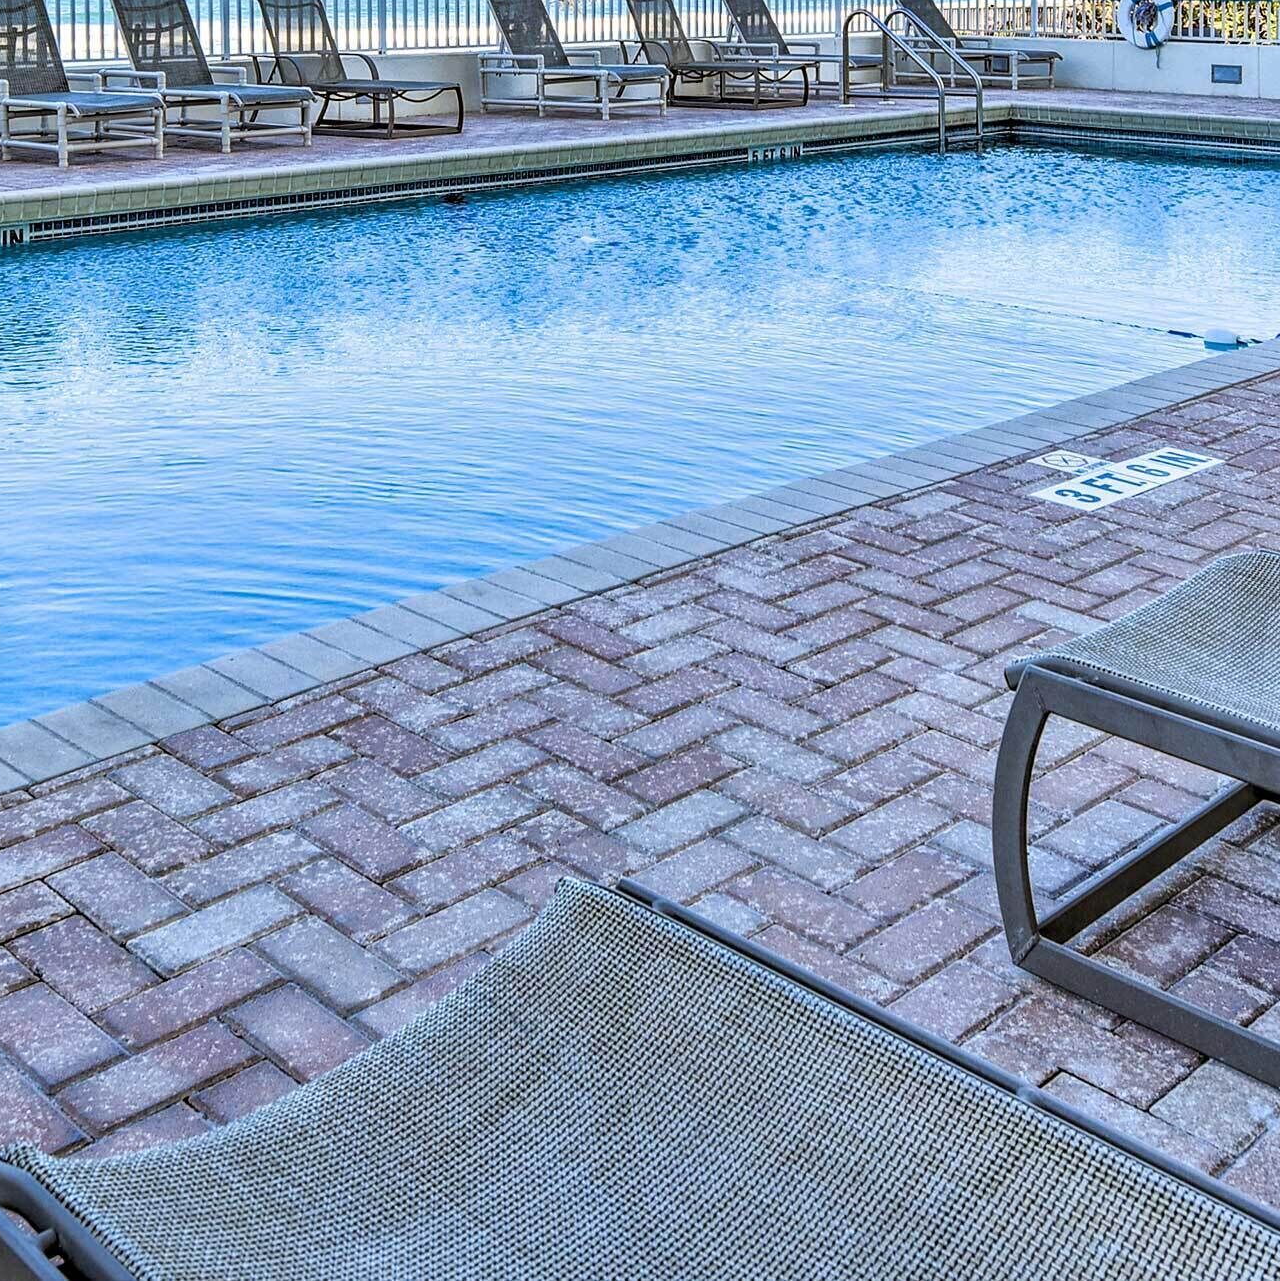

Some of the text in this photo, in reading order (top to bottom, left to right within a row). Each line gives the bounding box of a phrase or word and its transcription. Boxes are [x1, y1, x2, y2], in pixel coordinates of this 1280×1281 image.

[752, 149, 759, 160] 5
[763, 148, 776, 160] FT
[790, 145, 801, 158] IN
[2, 228, 24, 248] IN
[1054, 488, 1102, 504] 3
[1126, 464, 1171, 477] 6
